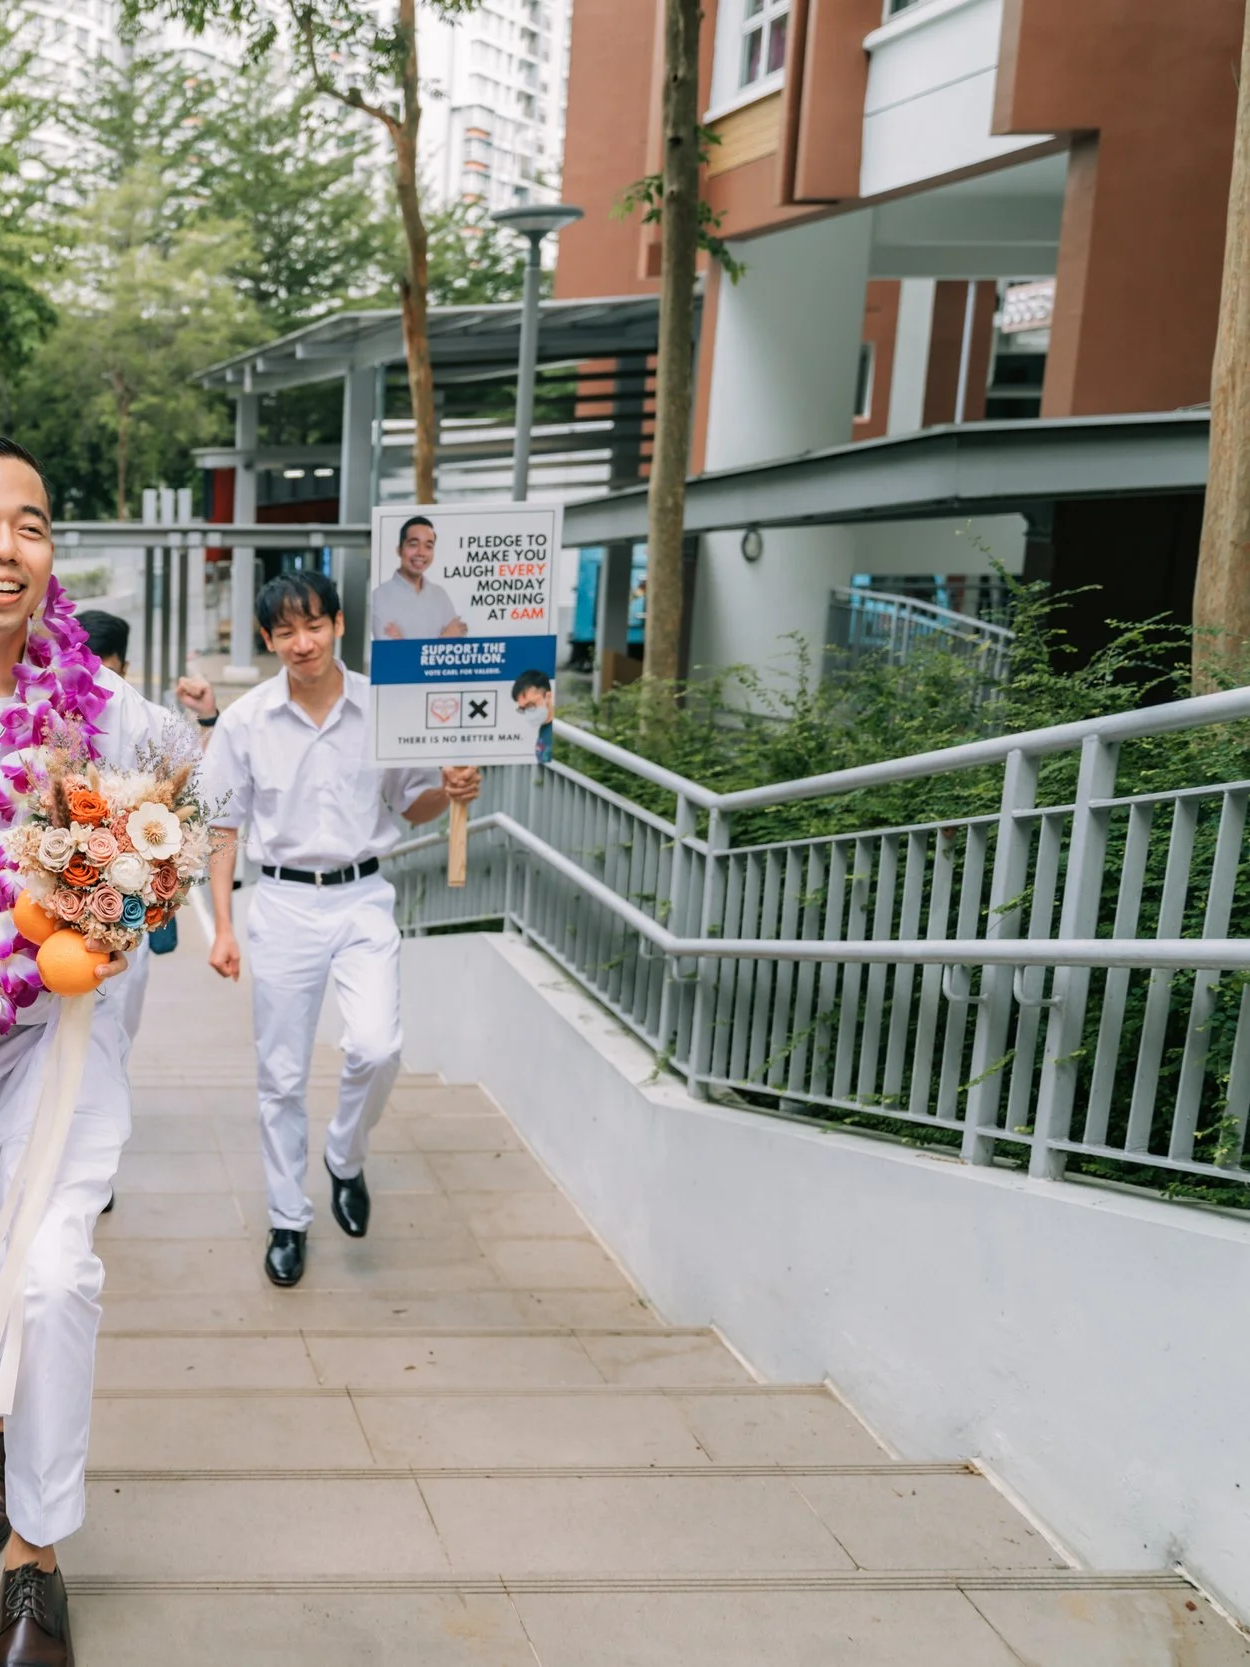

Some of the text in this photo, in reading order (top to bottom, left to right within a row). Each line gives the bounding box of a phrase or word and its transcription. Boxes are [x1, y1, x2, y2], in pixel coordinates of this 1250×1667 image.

[459, 534, 547, 549] I PLEDGE TO
[466, 549, 547, 563] MAKE YOU
[443, 563, 546, 579] LAUGH EVERY
[476, 578, 545, 592] MONDAY
[470, 592, 545, 607] MORNING
[487, 607, 545, 621] AT 6AM
[421, 642, 506, 656] SUPPORT THE
[420, 653, 506, 666] REVOLUTION.
[398, 736, 427, 744] THERE
[430, 736, 439, 744] IS
[442, 735, 457, 743] NO
[461, 734, 494, 743] BETTER
